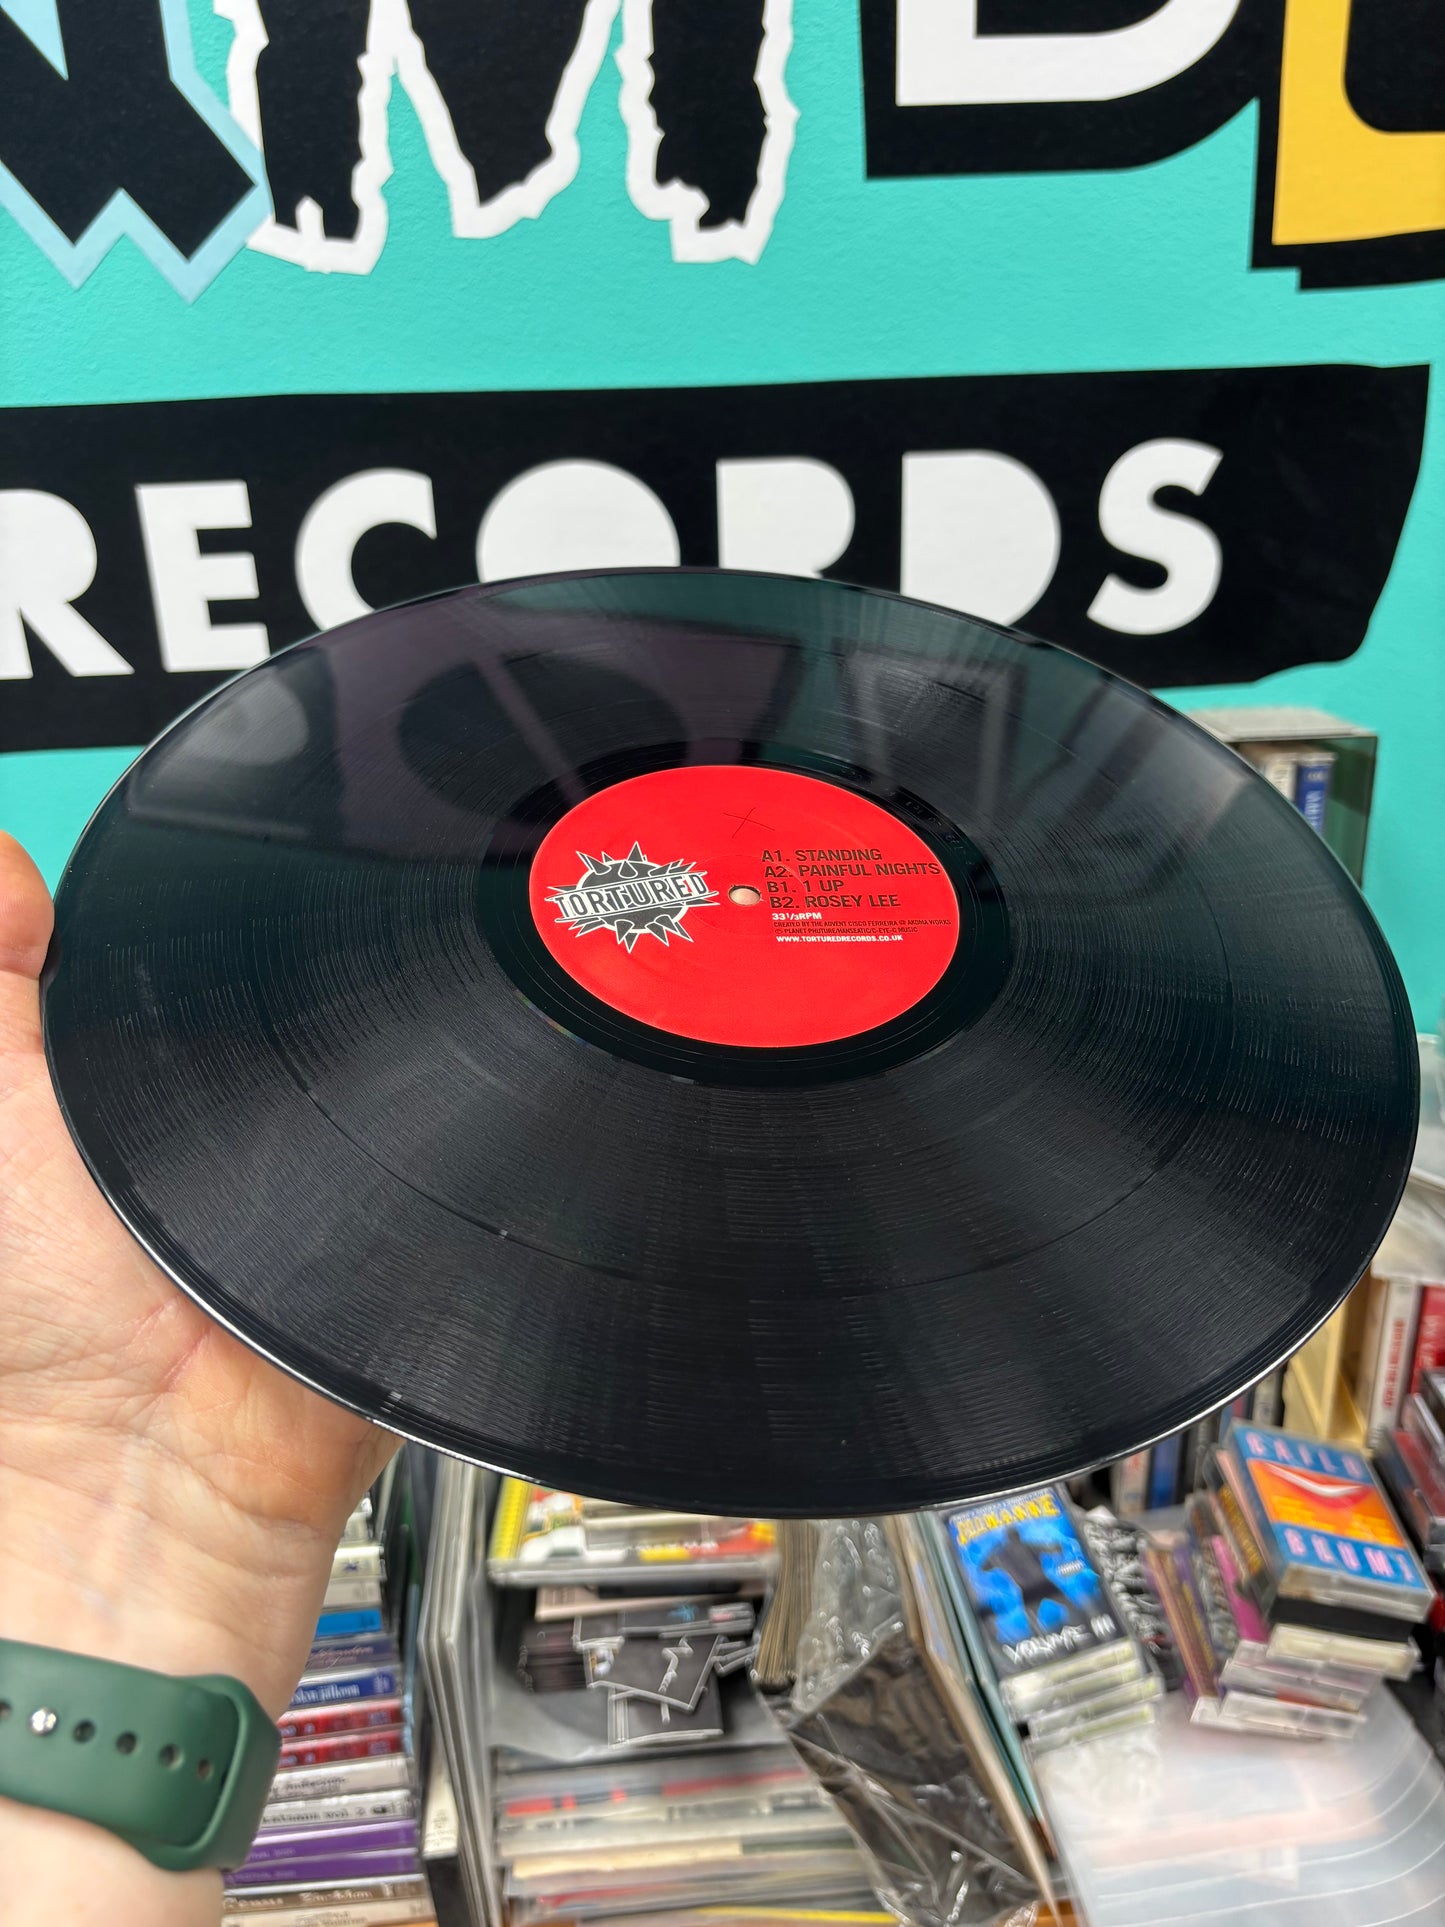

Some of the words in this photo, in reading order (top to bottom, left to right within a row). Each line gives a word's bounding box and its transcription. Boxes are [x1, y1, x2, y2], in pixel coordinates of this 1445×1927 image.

[762, 850, 790, 862] A1.
[796, 849, 882, 861] STANDING
[765, 866, 793, 878] A2.
[800, 864, 872, 877] PAINFUL
[876, 863, 941, 876] NIGHTS
[767, 881, 796, 893] B1.
[803, 881, 811, 892] 1
[820, 880, 844, 891] UP
[553, 872, 709, 919] TORTURED
[770, 897, 799, 908] B2.
[805, 895, 863, 907] ROSEY
[870, 895, 901, 907] LEE
